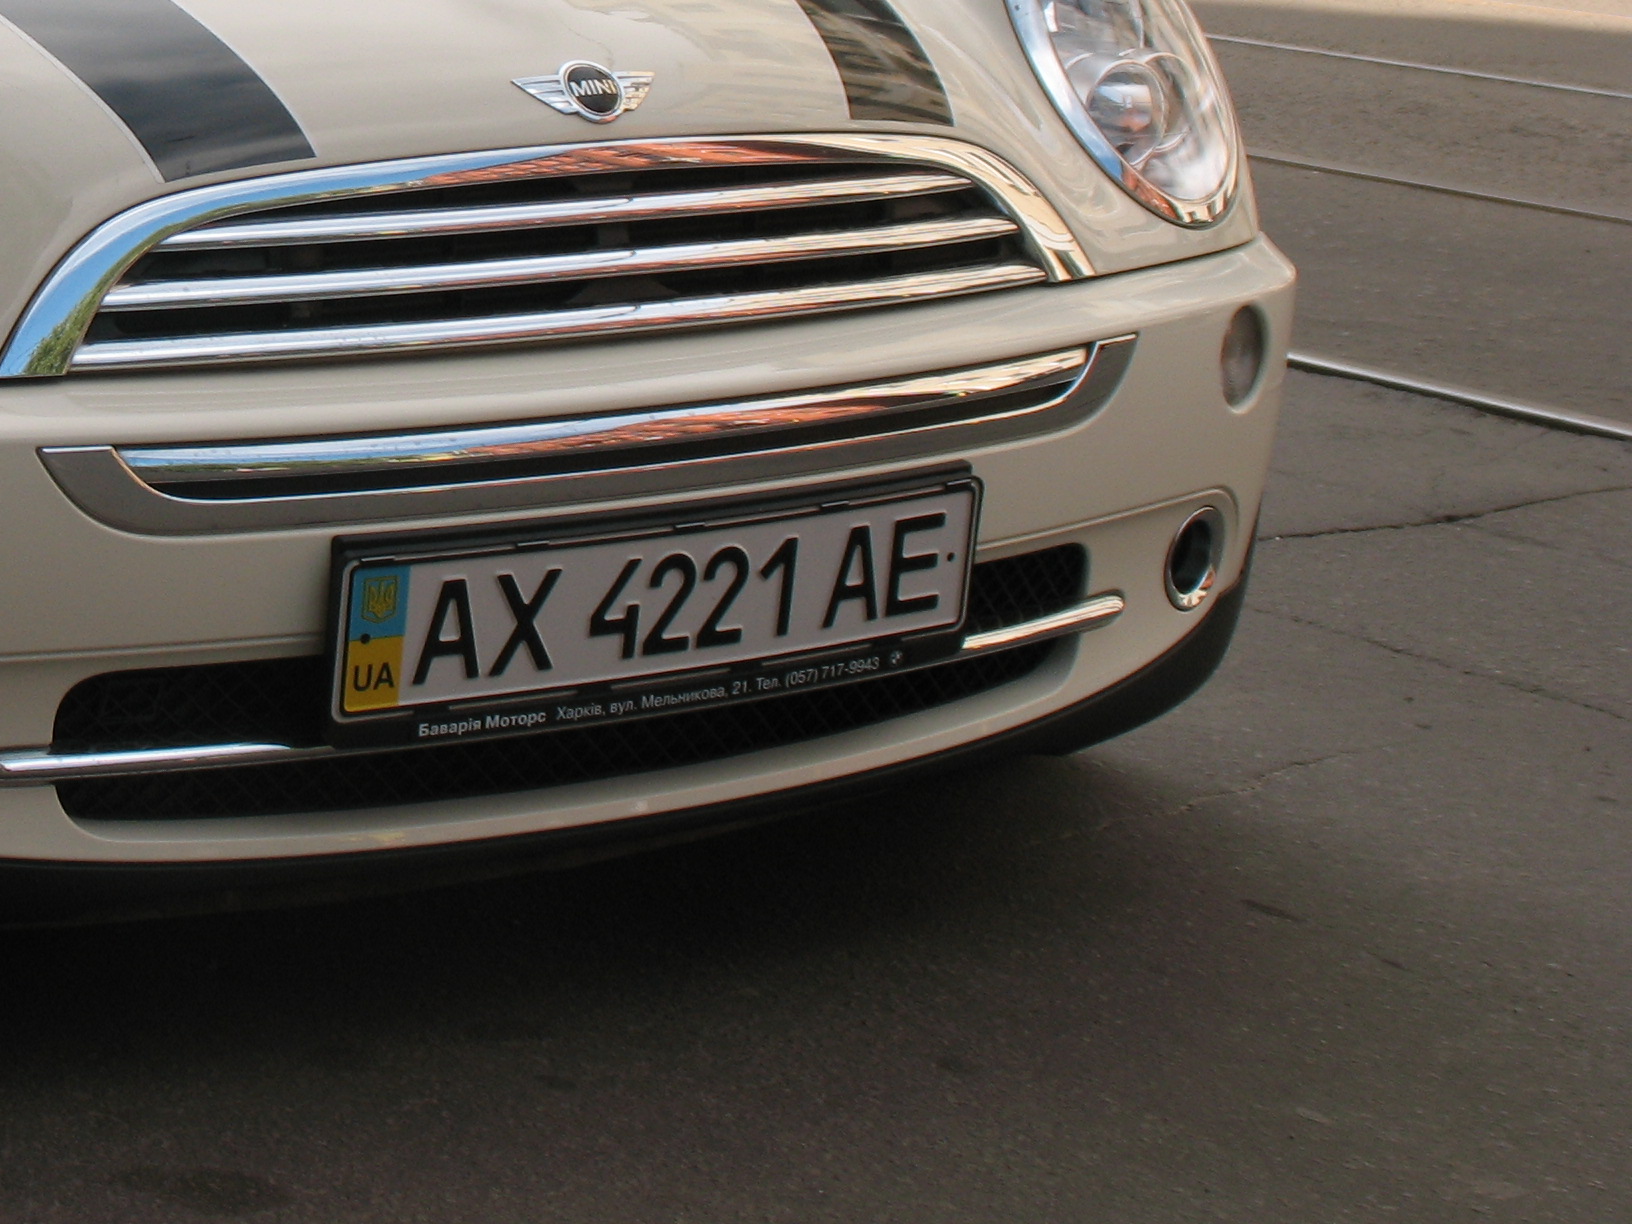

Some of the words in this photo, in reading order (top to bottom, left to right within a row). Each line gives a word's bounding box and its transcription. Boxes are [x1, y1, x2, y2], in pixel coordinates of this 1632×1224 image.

[569, 79, 618, 97] MINI
[412, 567, 563, 686] AX
[589, 536, 799, 660] 4221
[821, 511, 947, 630] AE
[353, 662, 395, 692] UA
[418, 718, 482, 737] Баварія
[485, 711, 547, 730] Моторс
[610, 700, 637, 715] вул.
[785, 668, 818, 689] (057)
[821, 656, 880, 678] 717-9943
